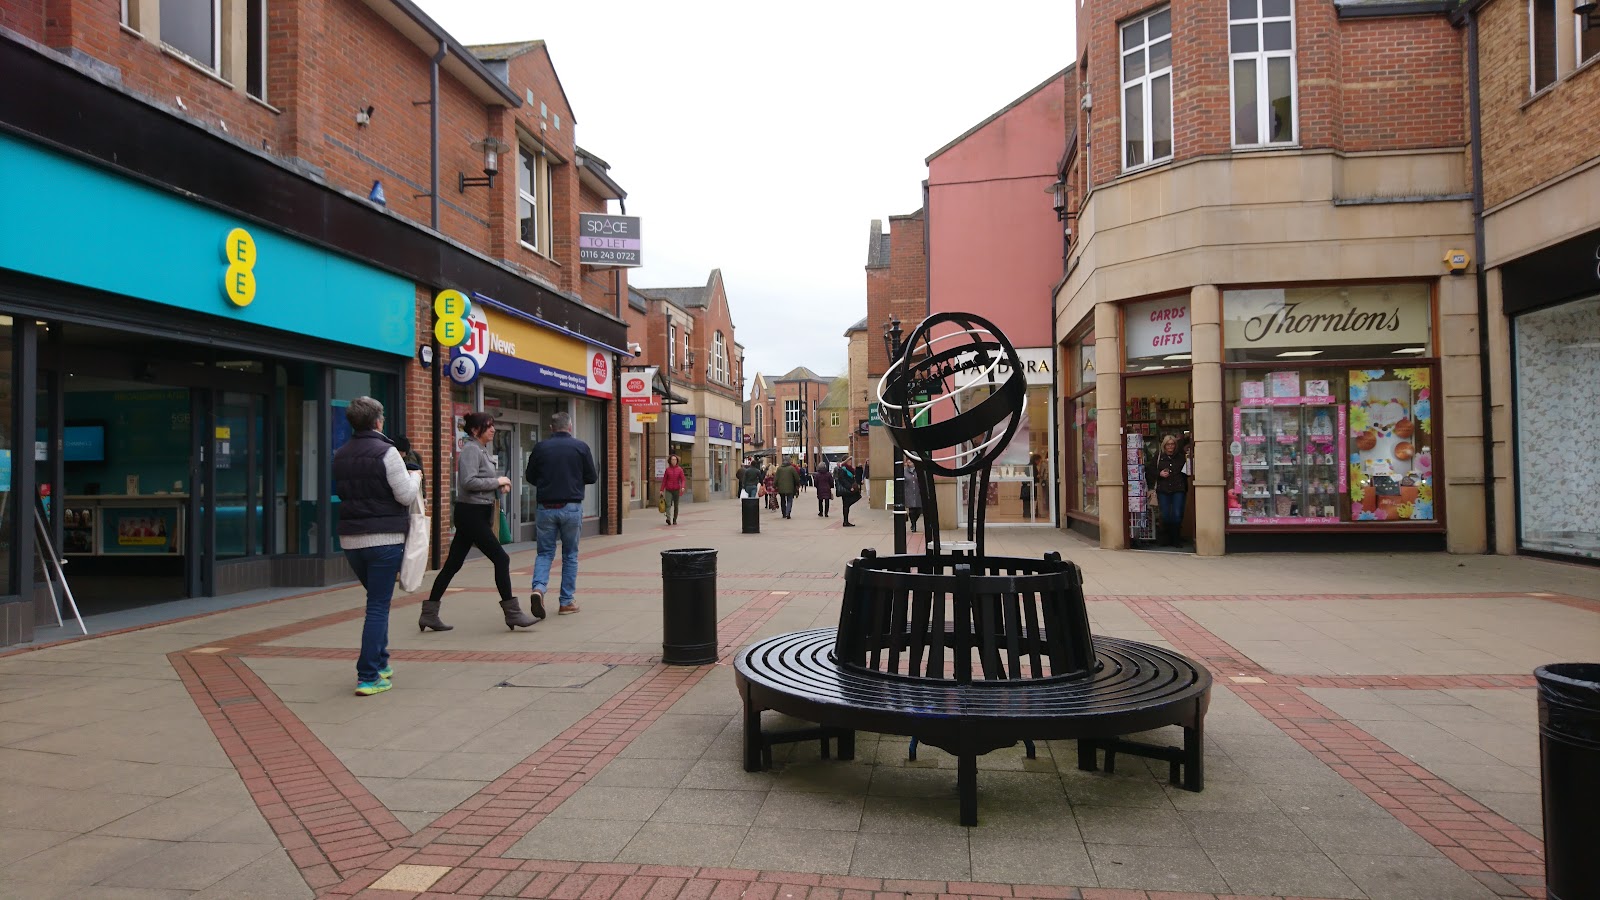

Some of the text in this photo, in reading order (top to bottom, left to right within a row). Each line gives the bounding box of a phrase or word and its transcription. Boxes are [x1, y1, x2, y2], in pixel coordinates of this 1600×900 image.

[588, 238, 627, 249] TO LET
[580, 250, 636, 261] 0116 243 0722
[1150, 306, 1186, 322] CARDS
[1163, 322, 1172, 333] &
[1244, 302, 1400, 342] Thorntons
[490, 332, 516, 355] News
[1152, 333, 1184, 347] GIFTS
[595, 358, 605, 367] POST
[593, 367, 606, 378] OFFICE
